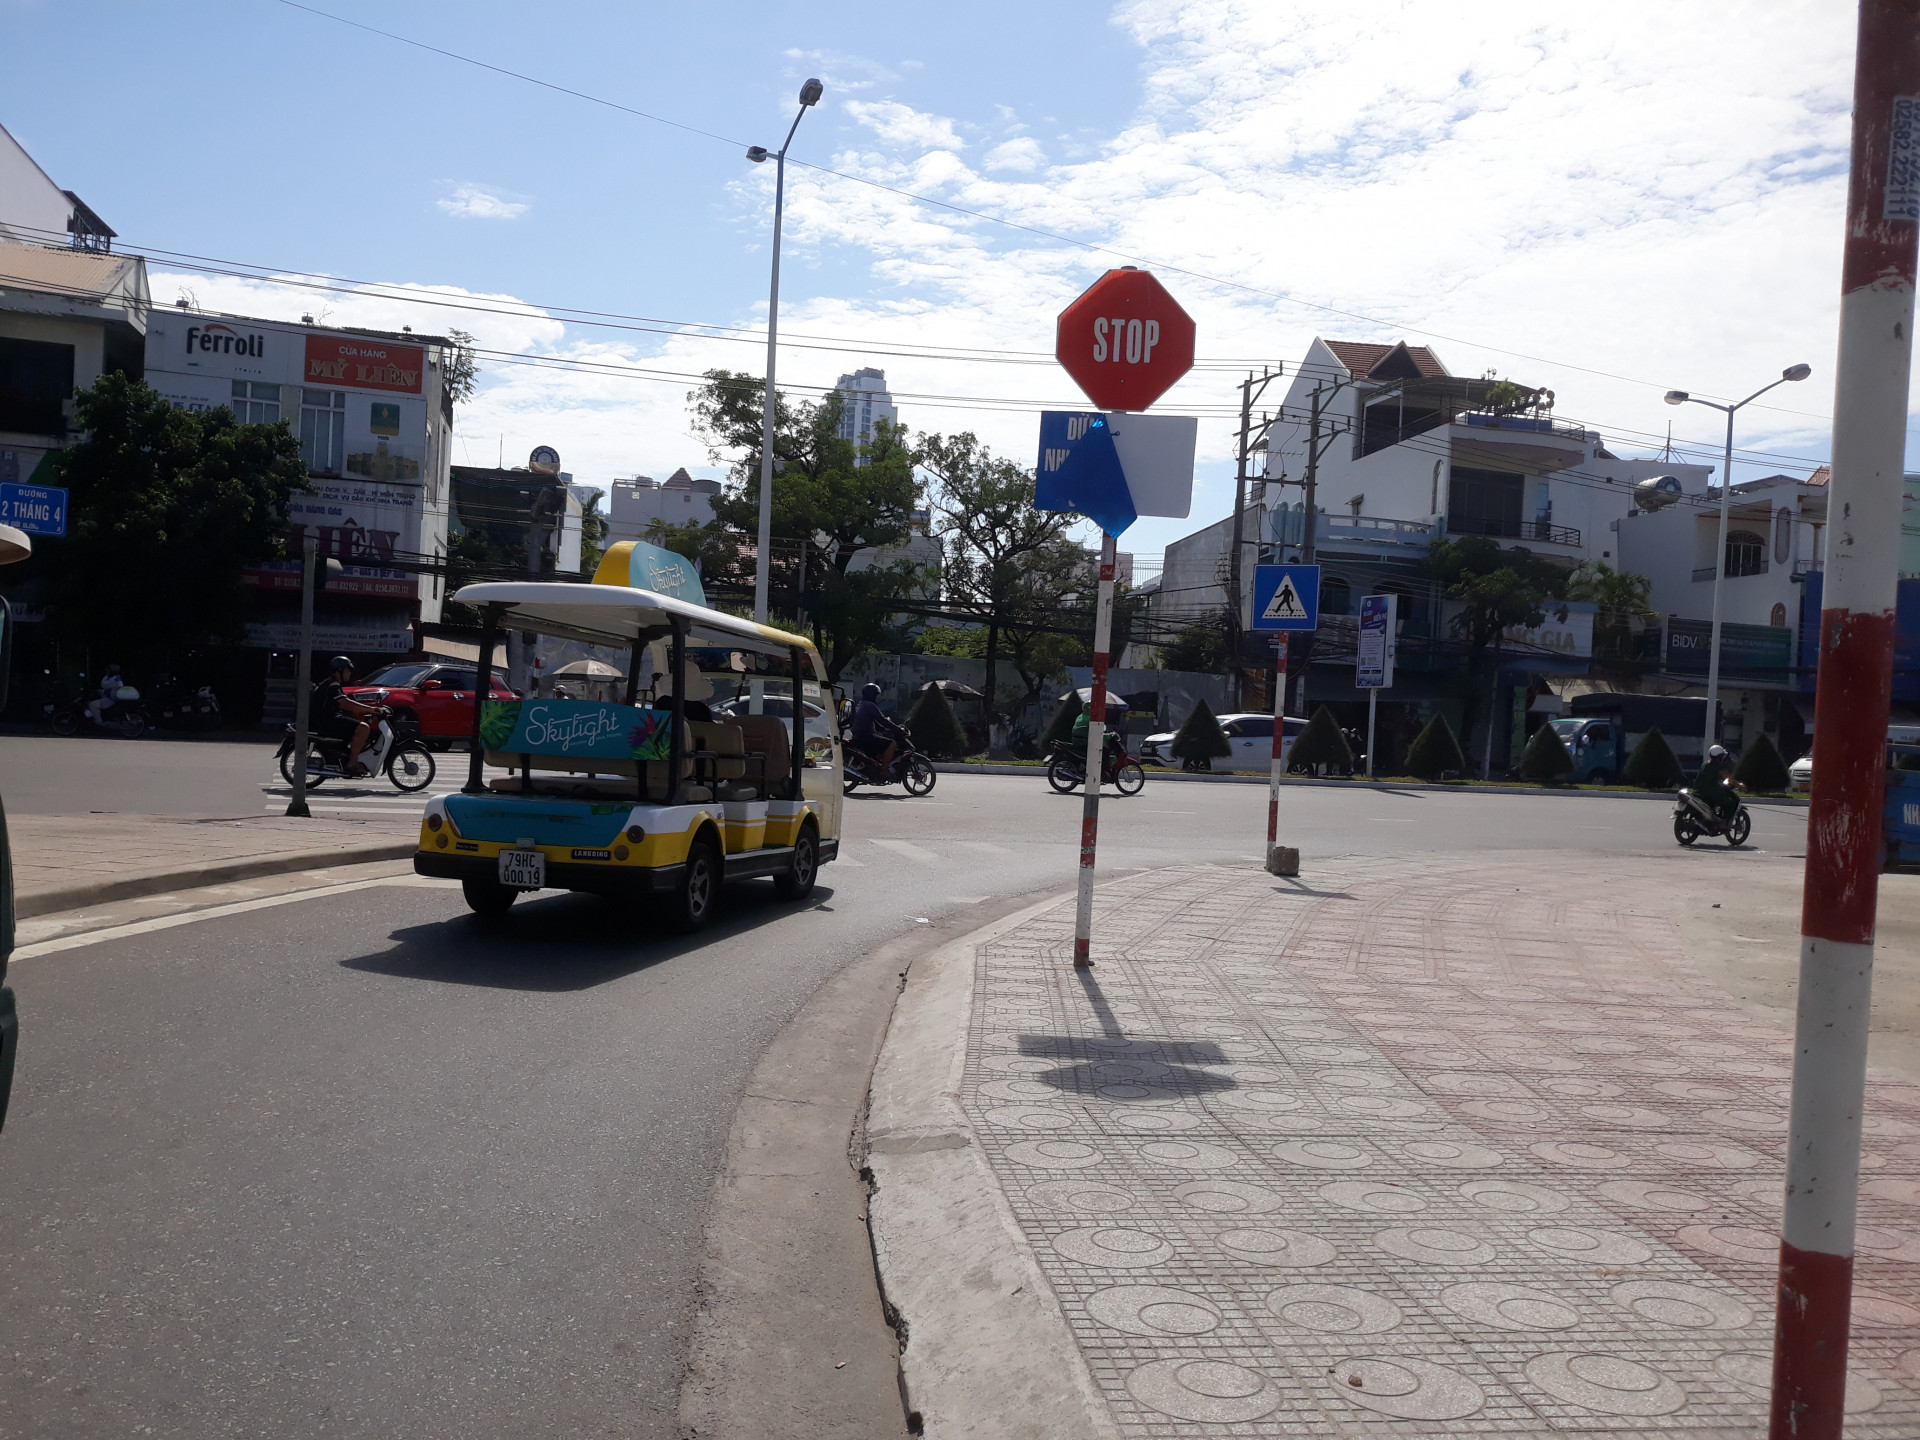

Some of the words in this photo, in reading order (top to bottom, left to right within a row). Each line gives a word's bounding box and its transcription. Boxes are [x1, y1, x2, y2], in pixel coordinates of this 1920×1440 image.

[187, 327, 264, 358] Ferroli
[1093, 316, 1159, 364] STOP
[360, 347, 387, 359] HÀNG
[356, 362, 418, 387] LIÊN
[1, 500, 9, 516] 2
[13, 500, 50, 521] THÁNG
[54, 506, 61, 523] 4
[648, 556, 687, 596] Skylight
[1541, 630, 1576, 651] GIA
[1672, 633, 1698, 649] BIDV
[525, 705, 620, 752] Skylight
[503, 866, 540, 884] 000.19
